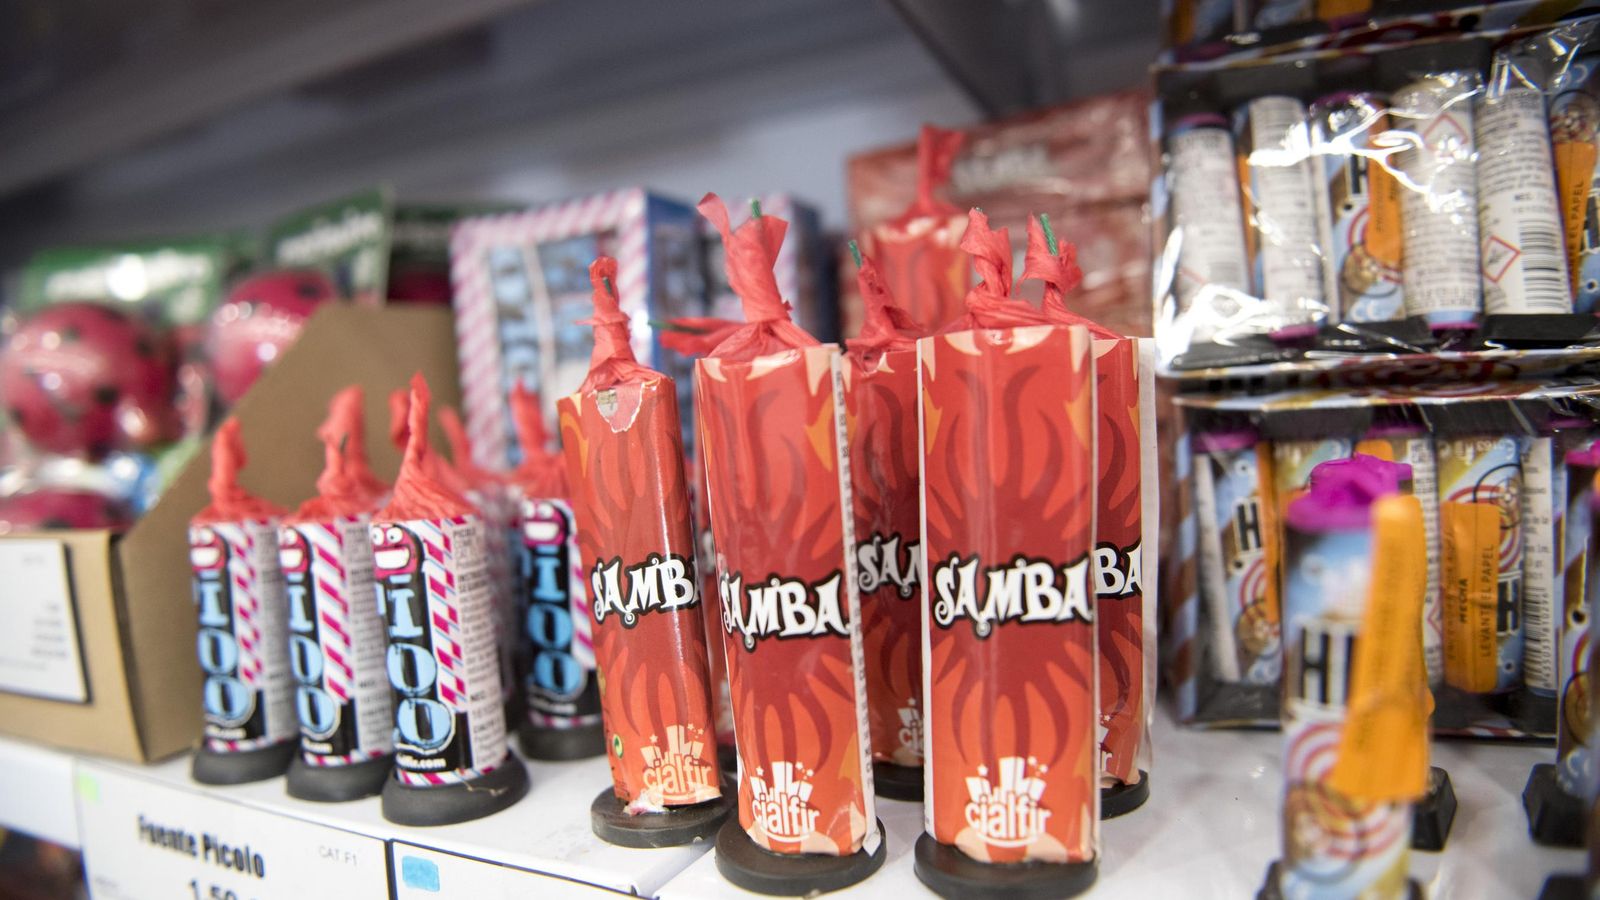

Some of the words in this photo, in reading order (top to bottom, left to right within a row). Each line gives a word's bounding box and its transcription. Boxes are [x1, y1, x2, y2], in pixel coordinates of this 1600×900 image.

[1481, 544, 1495, 573] PAPEL
[720, 573, 850, 650] SAMBA
[934, 555, 1094, 638] SAMBA
[643, 753, 713, 800] cialfir
[751, 792, 820, 837] cialfir
[964, 791, 1052, 840] cialfir
[138, 814, 197, 858] Fuente
[202, 832, 265, 879] Picolo
